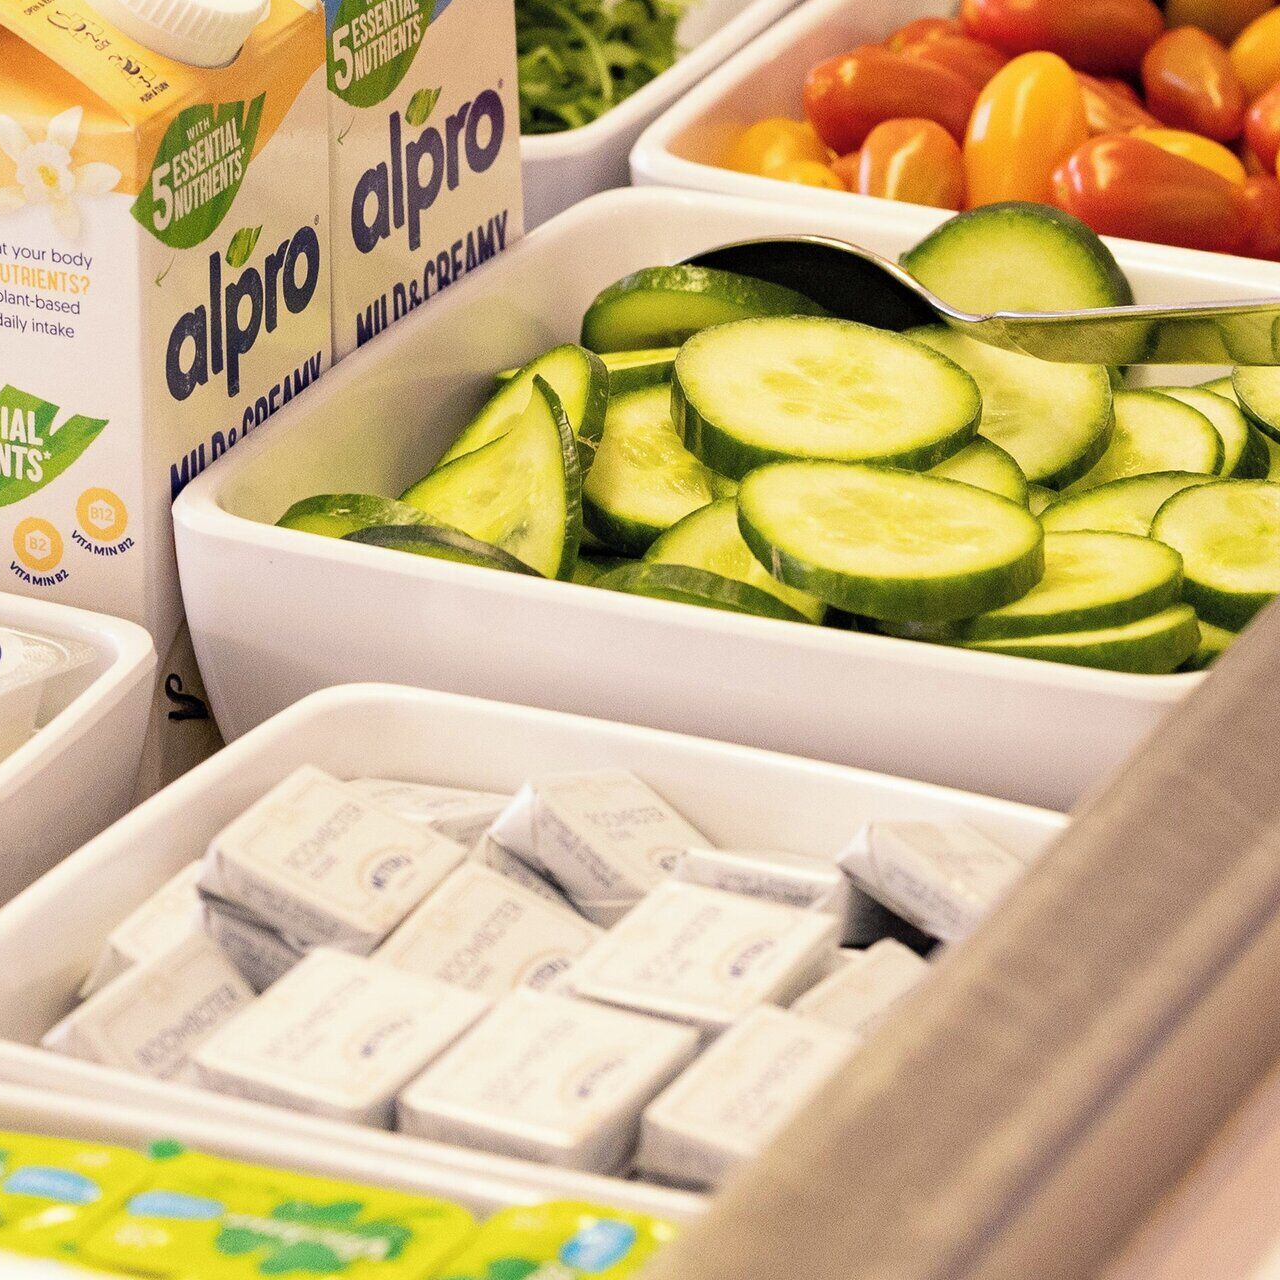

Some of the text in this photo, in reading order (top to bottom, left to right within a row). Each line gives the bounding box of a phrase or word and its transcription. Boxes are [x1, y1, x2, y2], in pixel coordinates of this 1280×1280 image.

[24, 2, 40, 16] OPEN
[85, 32, 99, 43] 2
[332, 24, 354, 91] 5
[139, 75, 151, 88] 3
[139, 91, 153, 103] PUSH
[186, 117, 211, 141] WITH
[151, 116, 242, 232] 5 ESSENTIAL
[350, 88, 505, 254] alpro
[12, 245, 46, 260] your
[51, 248, 93, 270] body
[165, 225, 320, 402] alpro
[31, 318, 75, 339] intake
[89, 507, 113, 522] B12
[29, 536, 47, 552] B2
[71, 529, 135, 557] VITAMIN B12
[9, 560, 70, 587] VITAMIN B2
